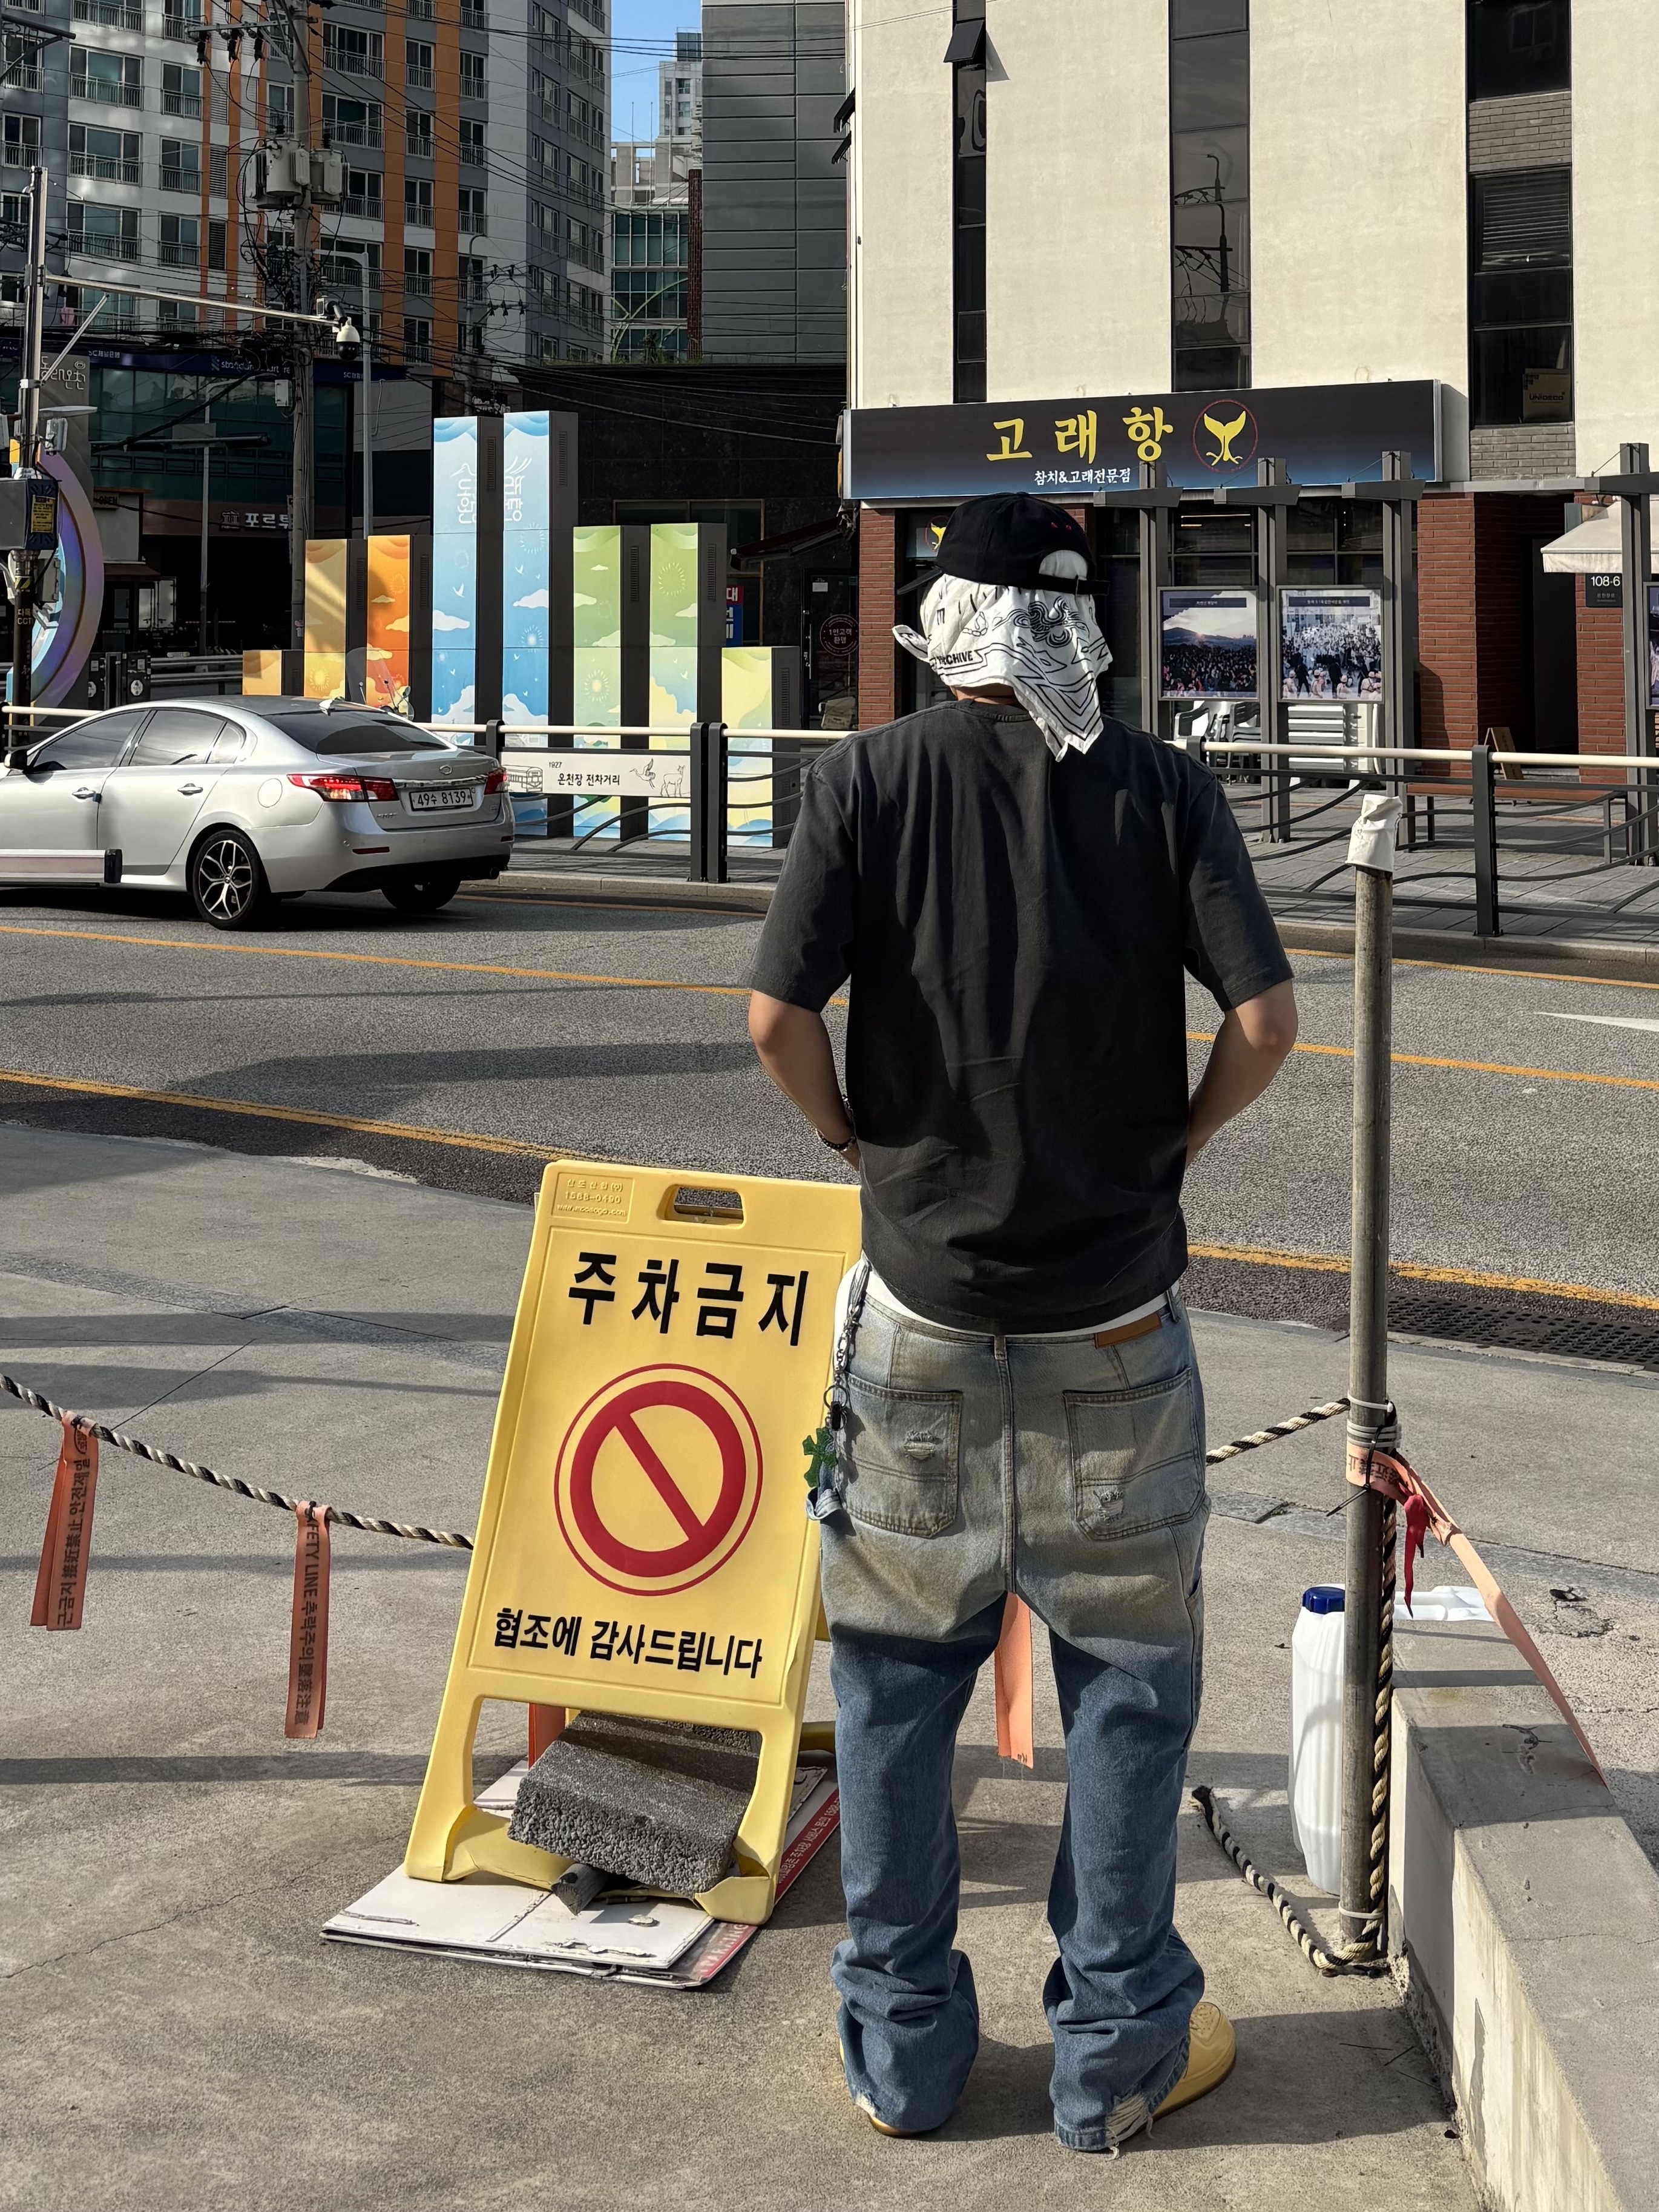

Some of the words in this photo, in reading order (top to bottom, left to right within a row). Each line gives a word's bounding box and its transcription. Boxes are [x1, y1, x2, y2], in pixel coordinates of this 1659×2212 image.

[986, 406, 1174, 464] 고래항
[1034, 468, 1131, 486] 참치&고래전문점
[1591, 576, 1621, 587] 108-6
[417, 793, 437, 806] 49수
[441, 791, 466, 805] 8139
[557, 773, 583, 786] 온천장
[586, 774, 620, 786] 전차거리
[568, 1252, 809, 1346] 주차금지
[69, 1458, 90, 1515] 안전제일
[304, 1564, 319, 1599] LINE
[298, 1600, 317, 1660] 추락주의
[494, 1607, 582, 1656] 협조에
[590, 1621, 763, 1679] 감사드립니다
